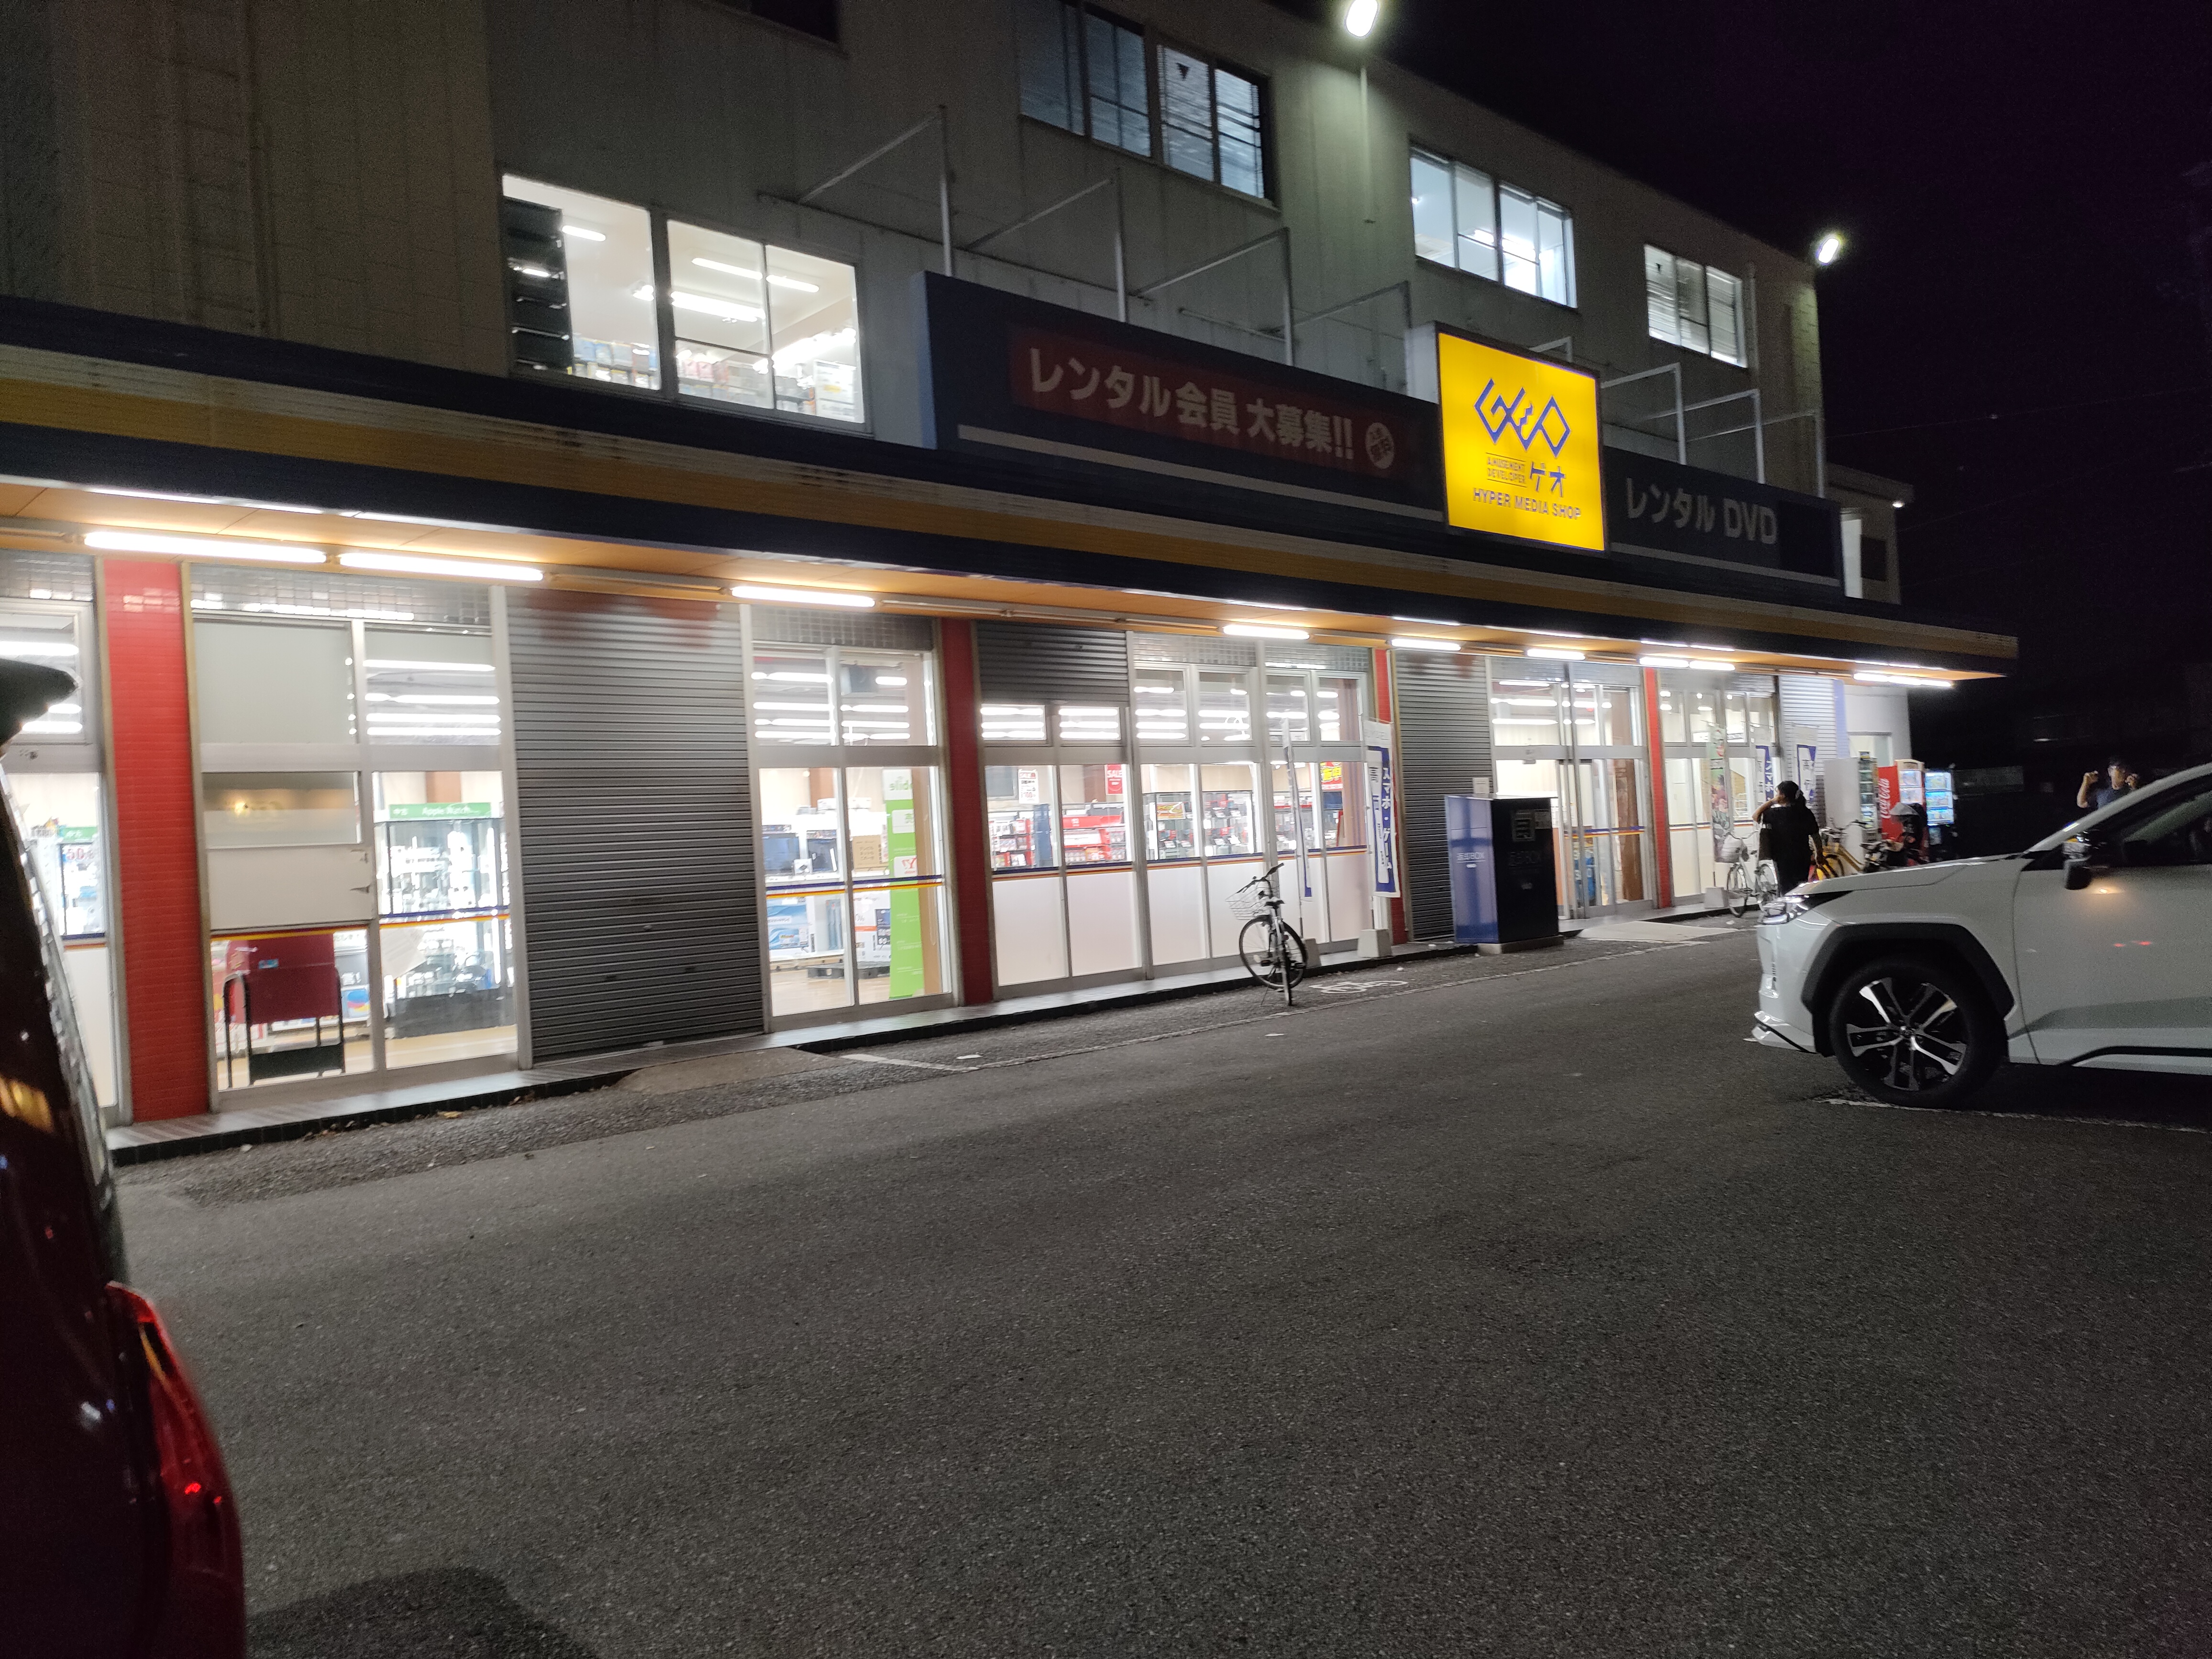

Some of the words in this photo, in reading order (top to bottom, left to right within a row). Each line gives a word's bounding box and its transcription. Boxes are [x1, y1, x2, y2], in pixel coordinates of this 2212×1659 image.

[1029, 347, 1240, 435] レンタル会員
[1246, 398, 1354, 460] 大募集!!
[1473, 378, 1571, 458] GEO
[1473, 487, 1511, 508] HYPER
[1515, 495, 1549, 515] MEDIA
[1552, 503, 1582, 520] SHOP
[1529, 461, 1566, 498] ゲオ
[1626, 477, 1716, 532] レンタル
[1723, 498, 1778, 545] DVD
[1106, 770, 1122, 778] SALE
